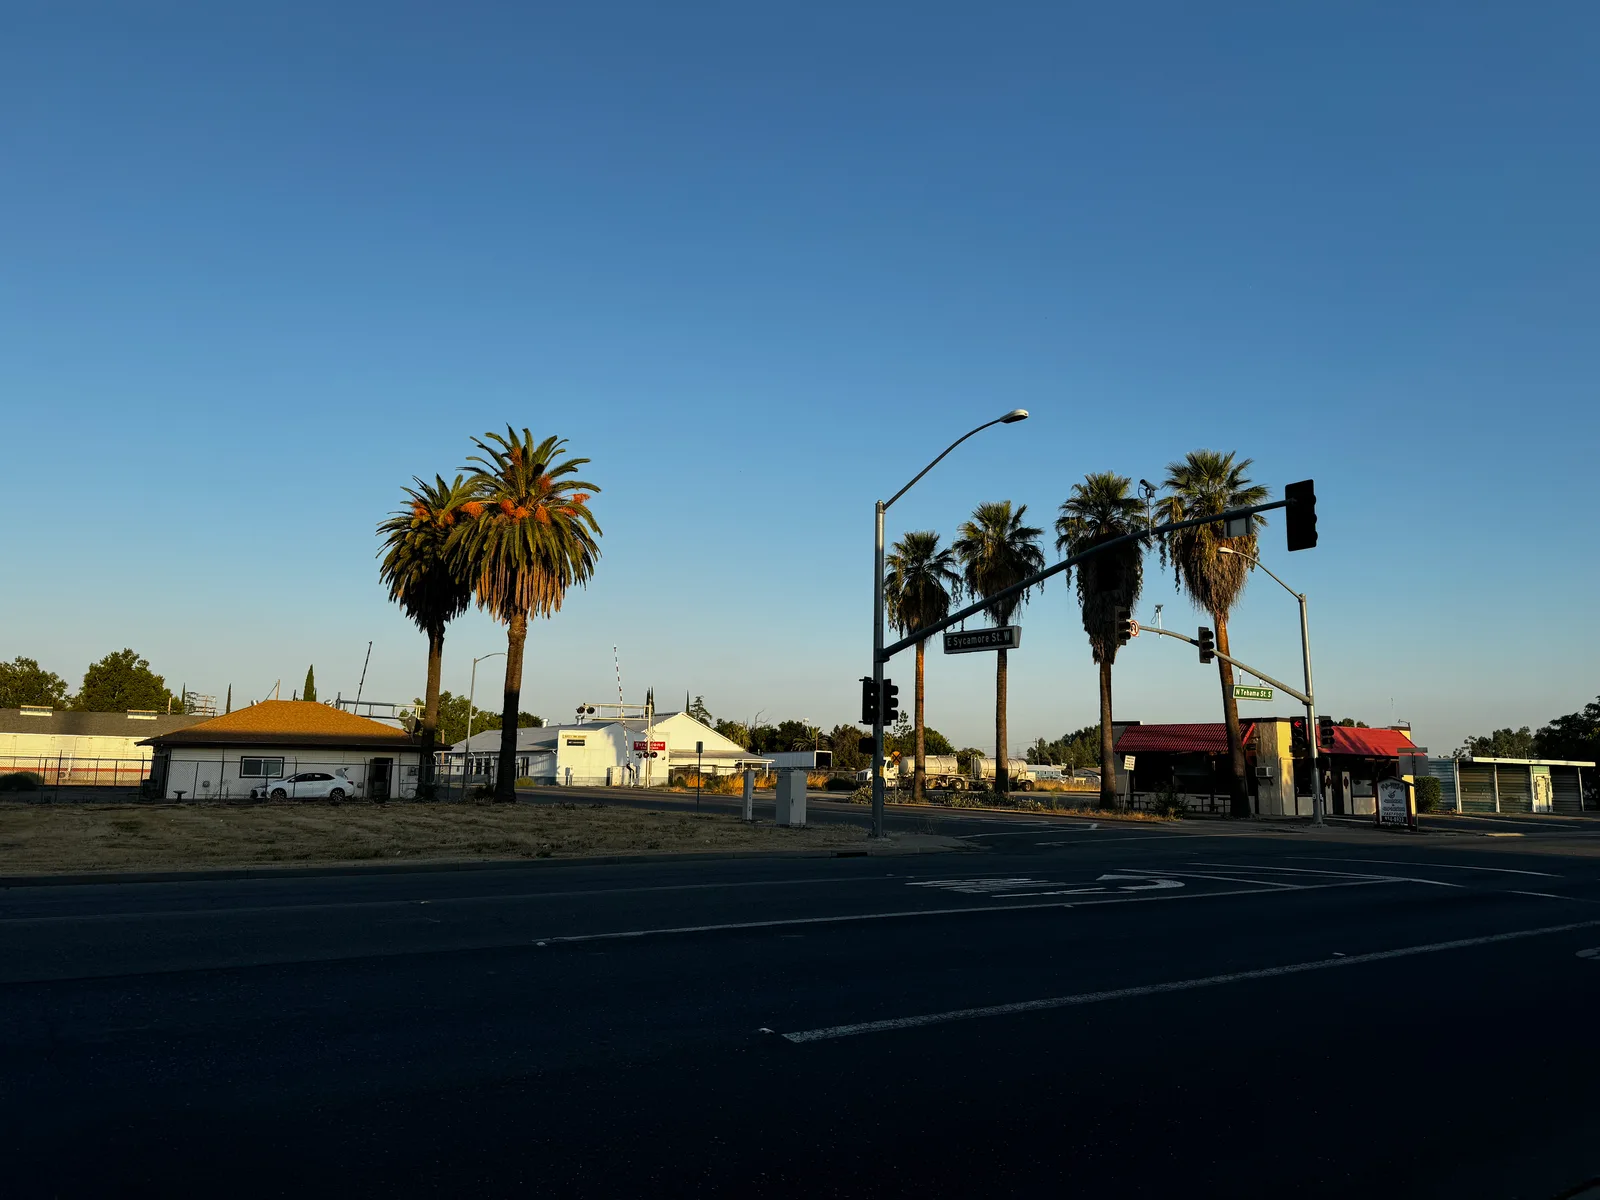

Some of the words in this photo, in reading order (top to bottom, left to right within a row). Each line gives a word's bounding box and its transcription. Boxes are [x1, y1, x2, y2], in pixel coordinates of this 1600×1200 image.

[947, 637, 952, 647] E
[953, 635, 989, 648] Sycamore
[991, 632, 1002, 643] St.
[1003, 630, 1010, 641] W
[1241, 689, 1259, 697] Tehama
